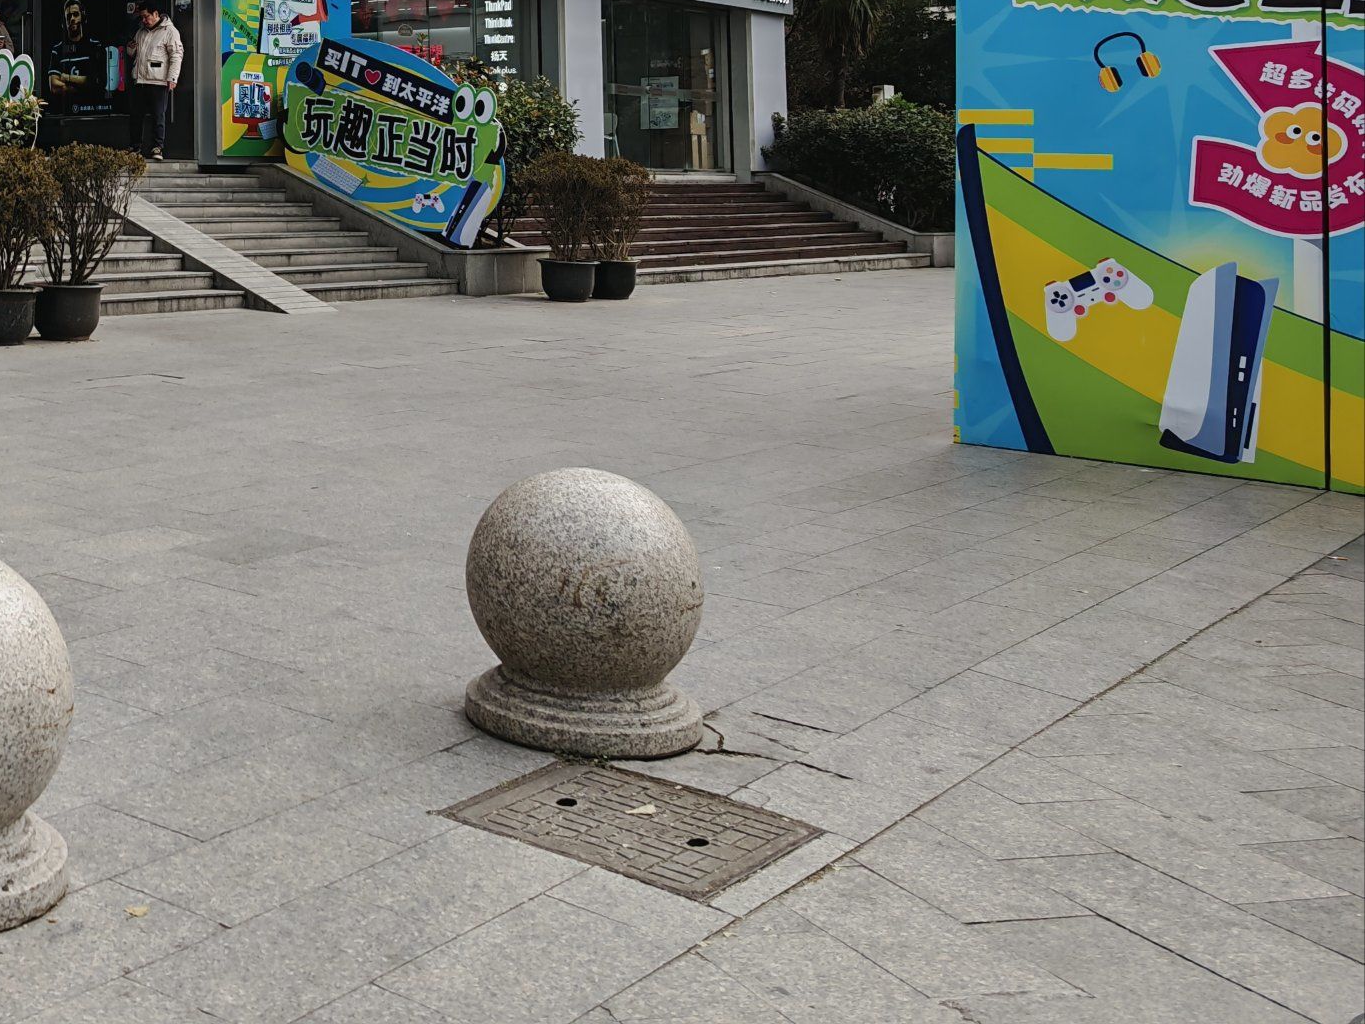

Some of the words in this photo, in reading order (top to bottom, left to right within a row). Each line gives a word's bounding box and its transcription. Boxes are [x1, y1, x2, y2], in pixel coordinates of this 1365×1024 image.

[484, 0, 513, 12] ThinkPad
[324, 48, 368, 78] 买IT
[381, 73, 450, 116] 到太平洋
[301, 97, 477, 180] 玩趣正当时
